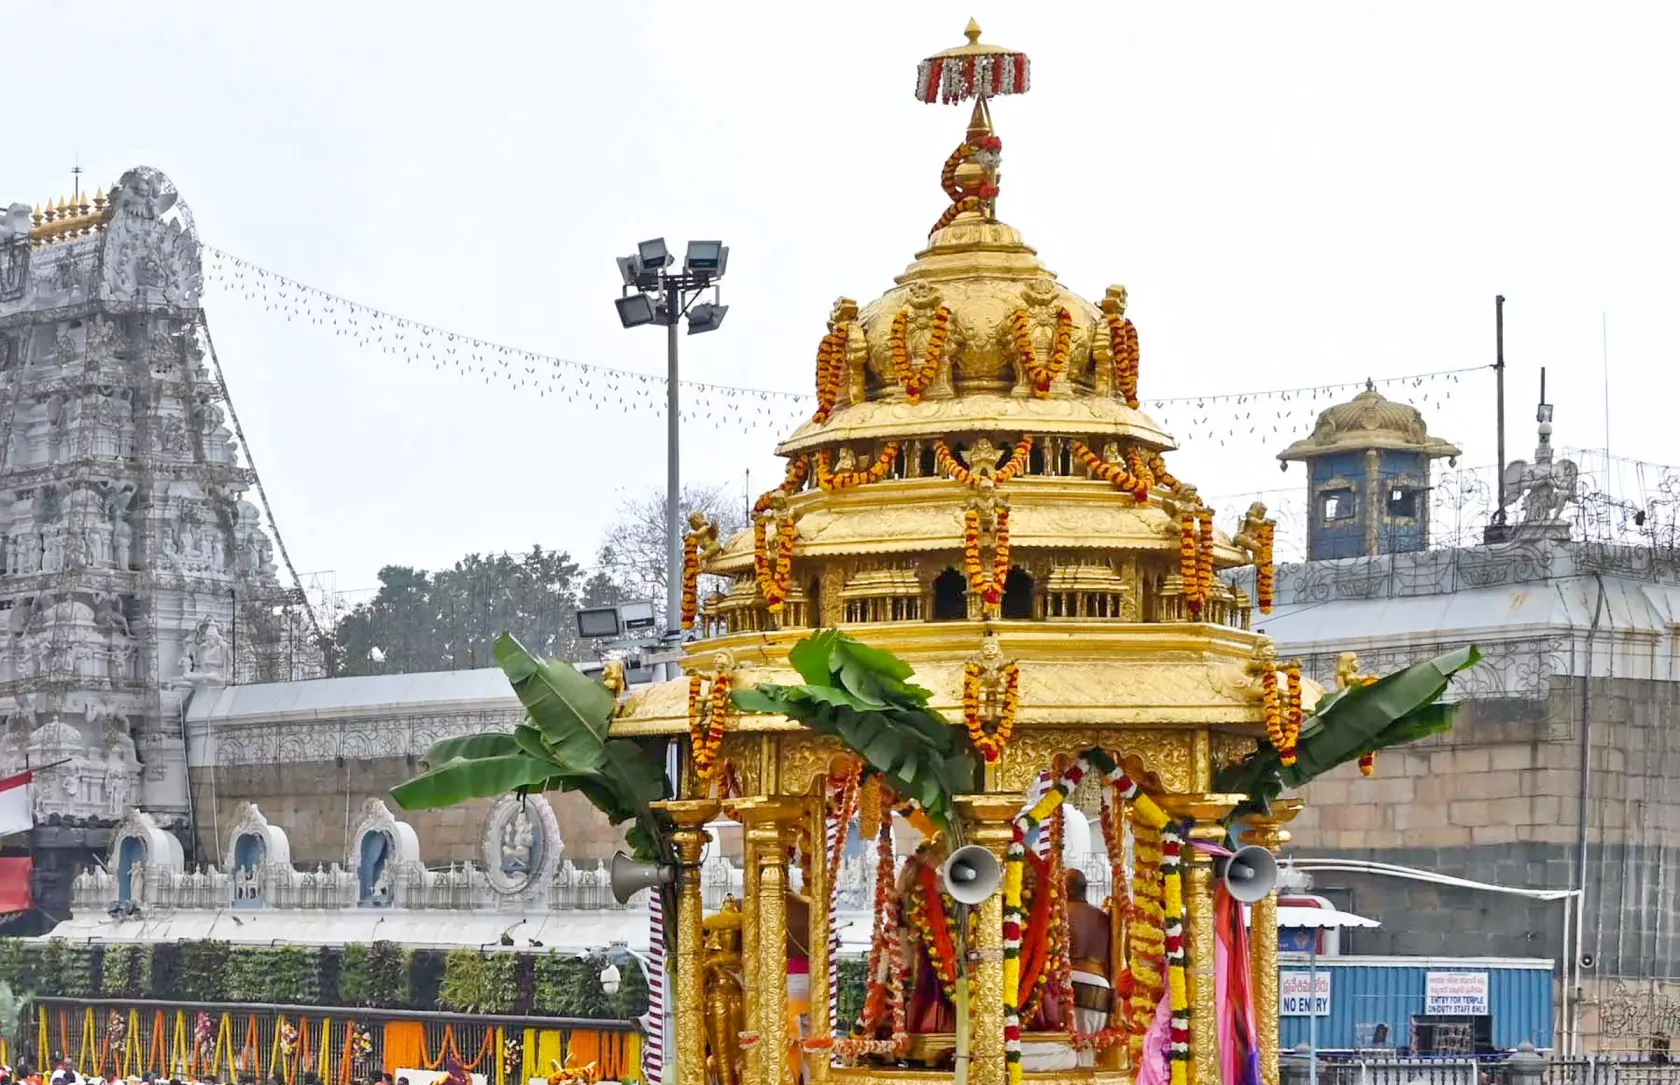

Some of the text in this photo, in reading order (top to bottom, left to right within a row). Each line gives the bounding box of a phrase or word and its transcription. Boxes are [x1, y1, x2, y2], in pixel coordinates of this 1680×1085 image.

[1430, 996, 1485, 1004] ENTRY FOR TEMPLE
[1283, 997, 1328, 1012] NO ENRY
[1454, 1005, 1471, 1013] STAFF
[1472, 1005, 1487, 1013] ONLY
